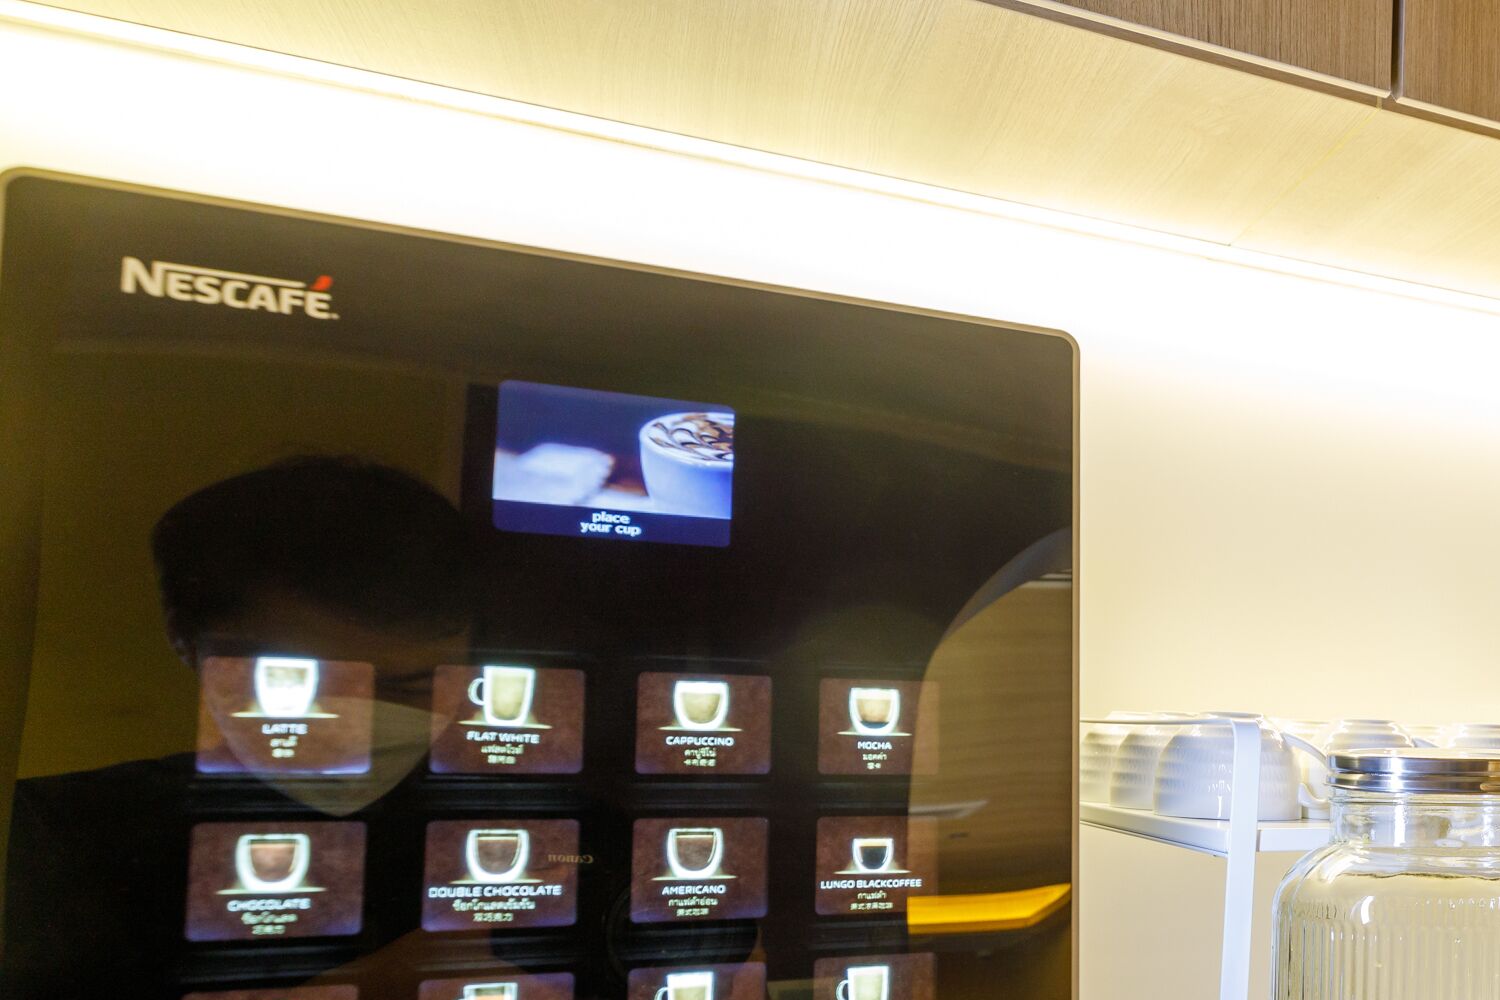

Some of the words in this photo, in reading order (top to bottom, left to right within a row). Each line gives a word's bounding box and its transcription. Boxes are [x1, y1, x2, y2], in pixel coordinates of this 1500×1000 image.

[592, 511, 630, 524] place
[580, 522, 612, 533] your
[615, 525, 641, 537] cup
[261, 723, 308, 735] LATTE
[466, 730, 498, 742] FLAT
[498, 733, 540, 744] WHITE
[665, 735, 735, 747] CAPPUCCINO
[857, 741, 893, 750] MOCHA
[661, 884, 727, 896] AMERICANO
[820, 880, 855, 889] LUNGO
[856, 879, 923, 888] BLACKCOFFEE
[428, 886, 482, 898] DOUBLE
[483, 885, 563, 897] CHOCOLATE
[226, 898, 311, 912] CHOCOLATE
